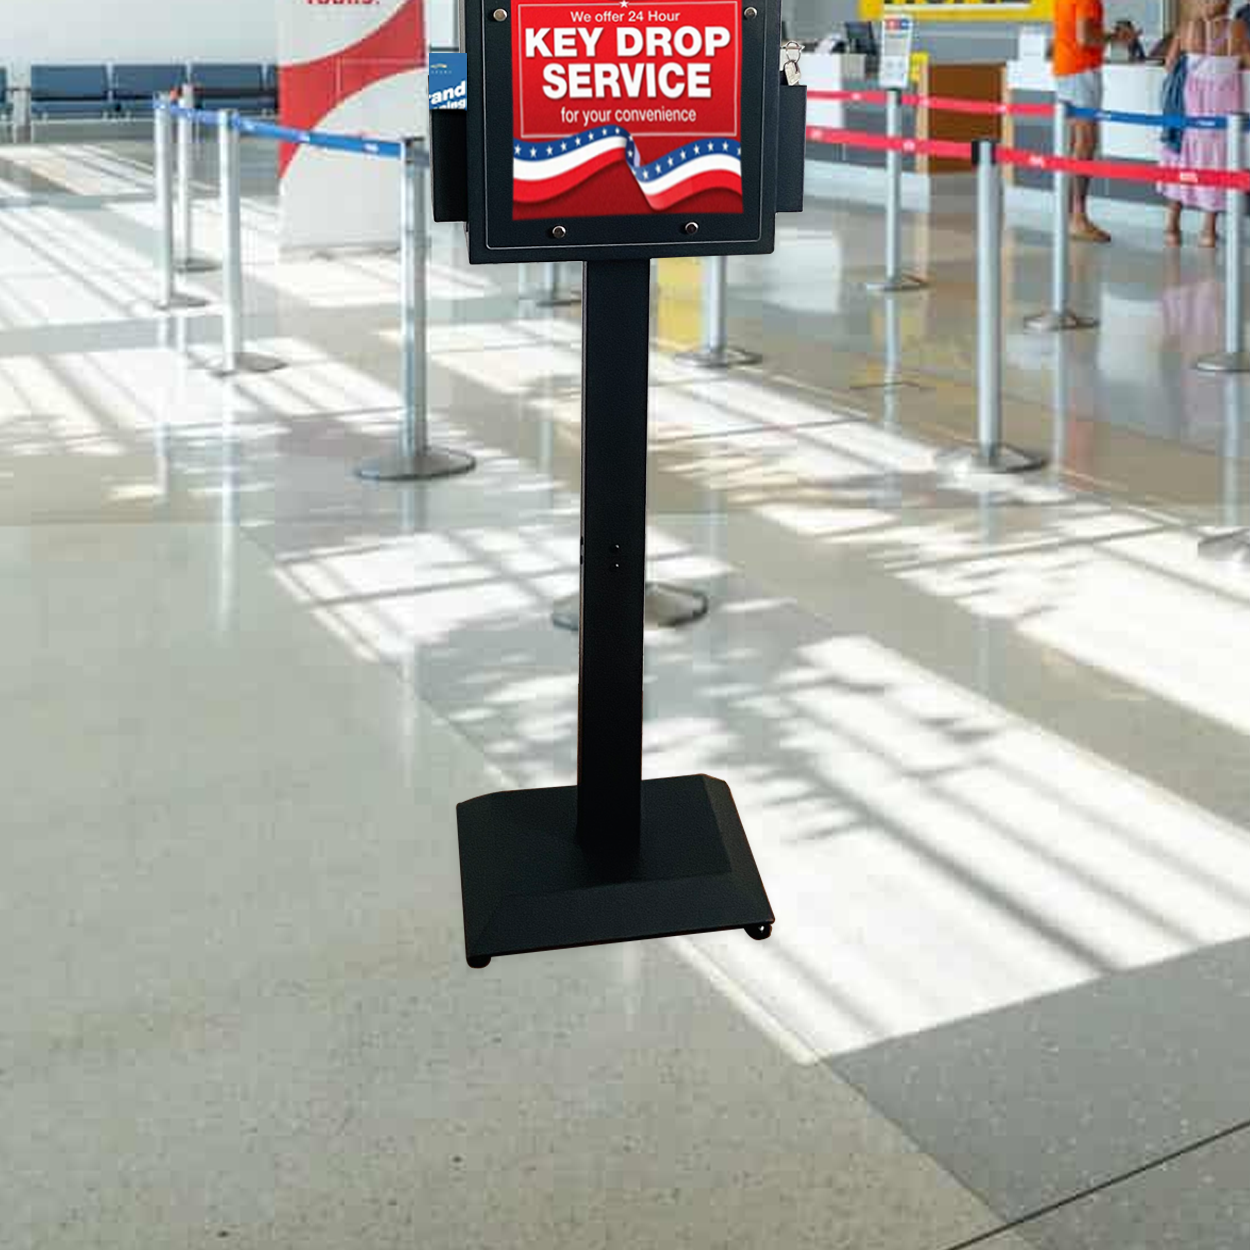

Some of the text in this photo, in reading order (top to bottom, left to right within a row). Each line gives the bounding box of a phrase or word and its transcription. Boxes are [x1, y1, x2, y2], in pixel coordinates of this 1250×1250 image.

[570, 11, 681, 23] We offer 24 Hour
[525, 25, 731, 58] KEY DROP
[542, 62, 712, 100] SERVICE
[561, 106, 697, 127] for your convenience
